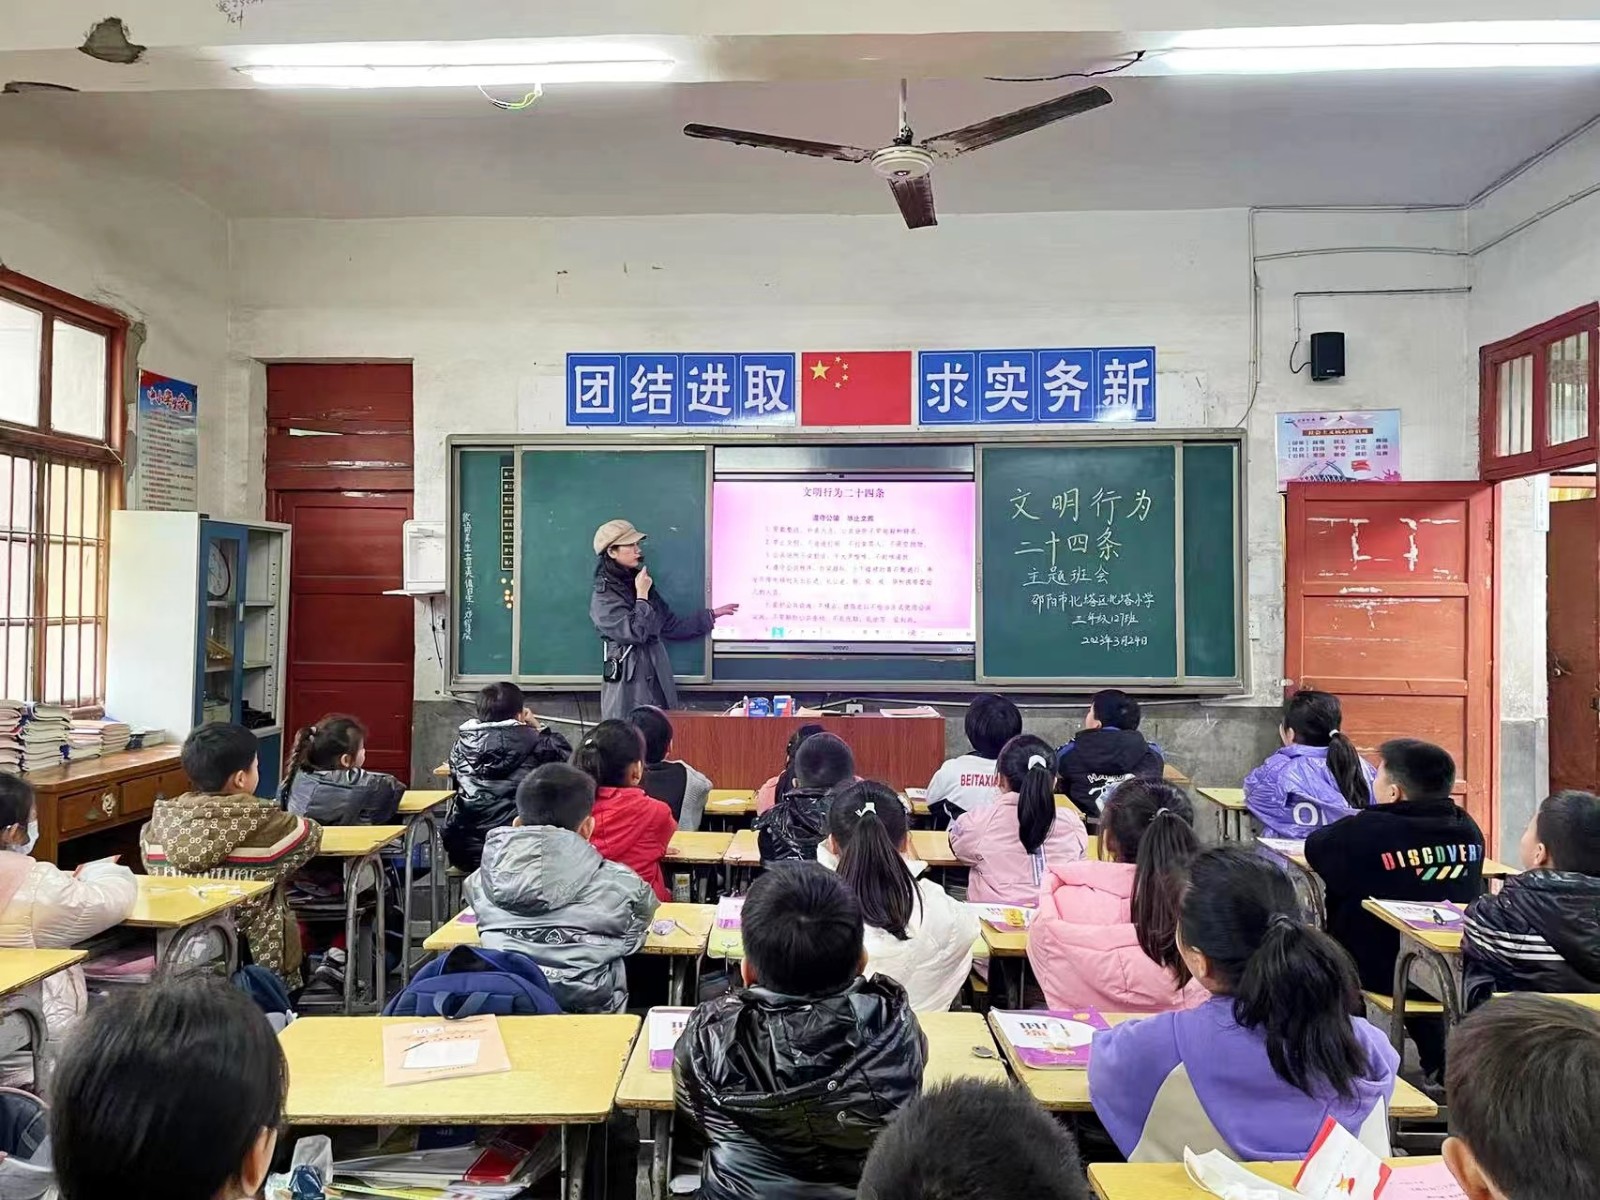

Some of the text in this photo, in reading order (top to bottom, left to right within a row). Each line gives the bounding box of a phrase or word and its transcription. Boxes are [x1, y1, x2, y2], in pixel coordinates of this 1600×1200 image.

[573, 362, 790, 416] 团结进取
[926, 356, 1150, 413] 求实务新
[803, 486, 885, 499] 文明行为二十四条
[1009, 487, 1152, 525] 文明行为
[1014, 527, 1122, 567] 二十四条
[1022, 565, 1110, 586] 主题班会
